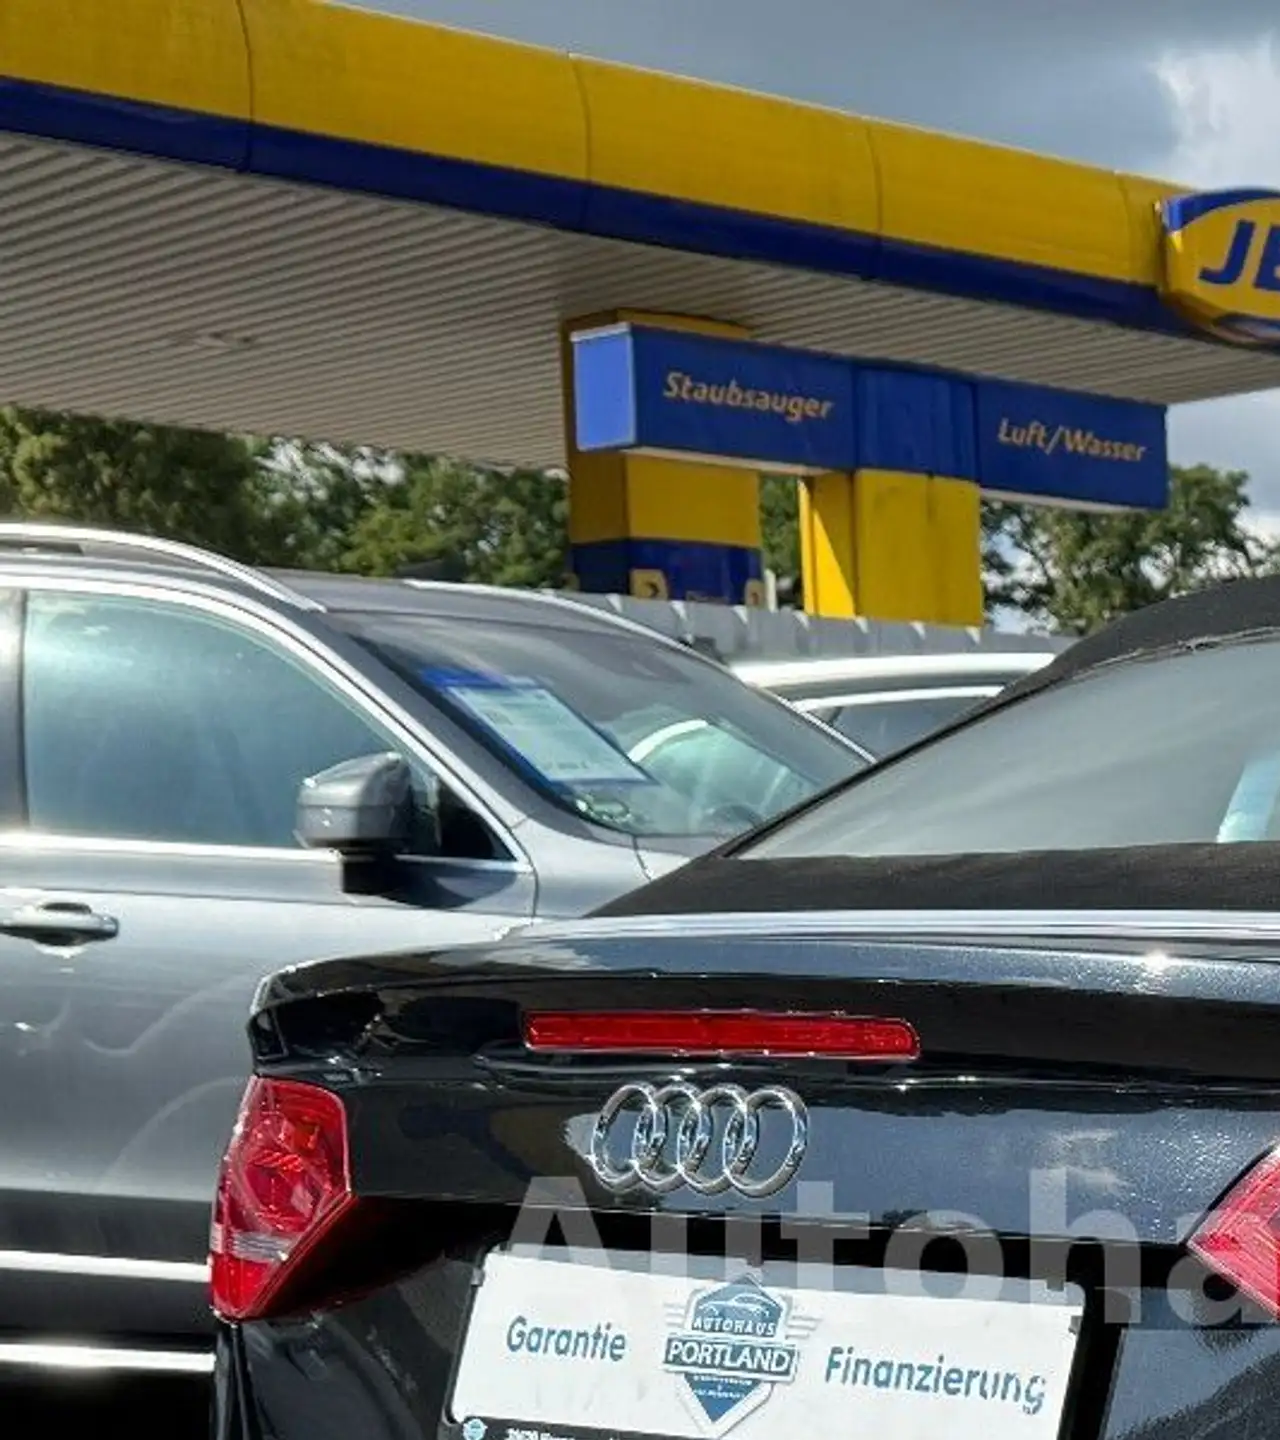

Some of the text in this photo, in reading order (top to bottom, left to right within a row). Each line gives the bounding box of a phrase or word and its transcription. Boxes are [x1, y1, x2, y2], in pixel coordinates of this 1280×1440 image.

[663, 372, 834, 424] Staubsauger
[998, 418, 1146, 463] Luft/Wasser
[506, 1315, 627, 1362] Garantie
[694, 1316, 776, 1336] AUTOHAUS
[668, 1341, 790, 1372] PORTLAND
[824, 1346, 1046, 1415] Finanzierung
